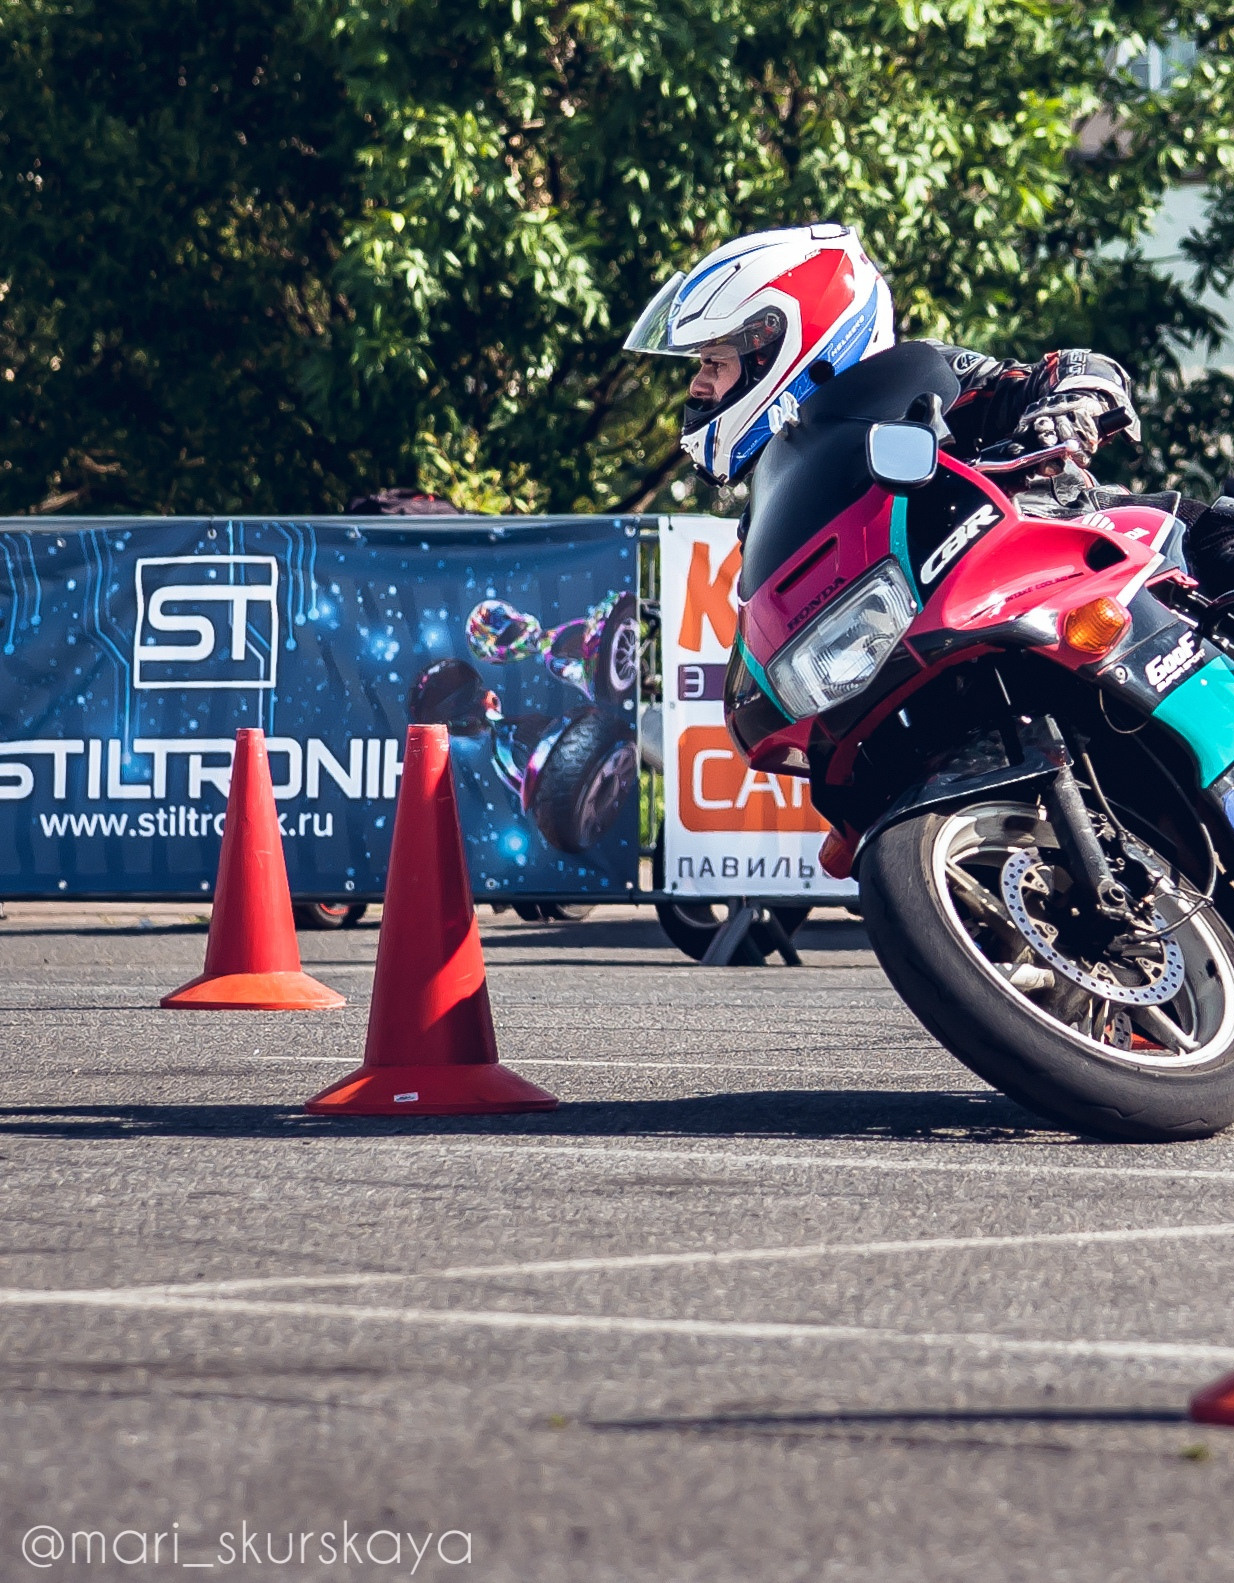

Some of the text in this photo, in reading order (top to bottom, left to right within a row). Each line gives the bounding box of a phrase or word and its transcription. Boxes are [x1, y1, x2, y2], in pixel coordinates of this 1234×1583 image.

[919, 503, 1000, 585] CBR
[139, 585, 275, 661] ST
[786, 576, 848, 631] HONDA
[1144, 630, 1195, 687] 600F
[0, 737, 404, 799] STILTRONI
